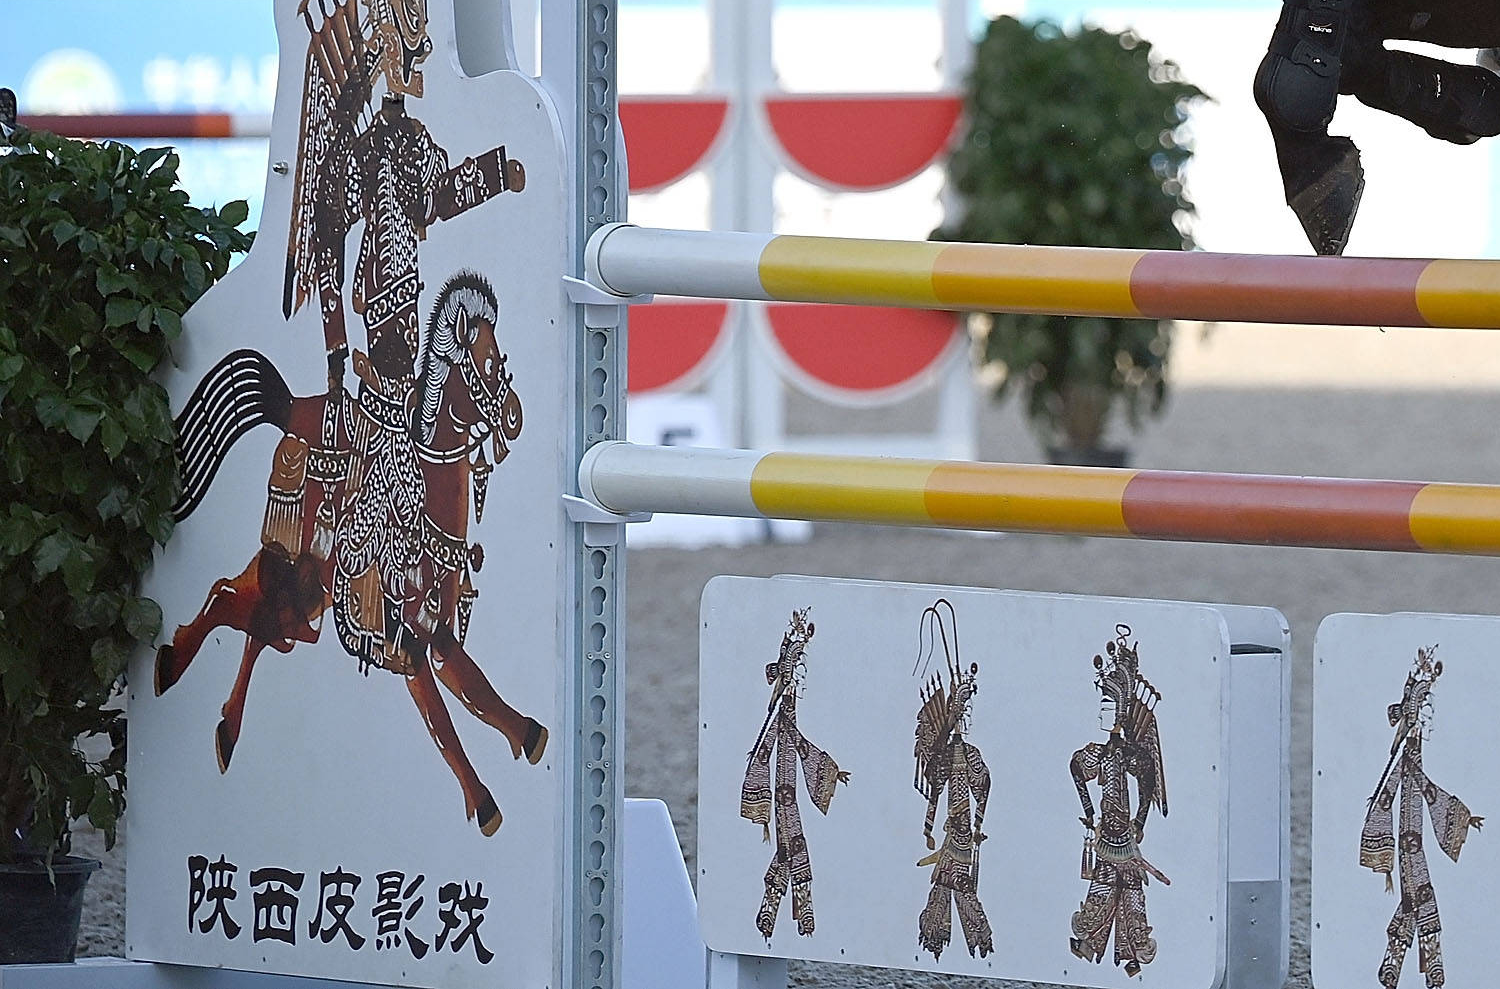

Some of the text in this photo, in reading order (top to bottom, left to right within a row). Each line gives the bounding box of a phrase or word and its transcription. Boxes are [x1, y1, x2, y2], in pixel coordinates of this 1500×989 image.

[187, 853, 495, 965] 陕西皮影戏
